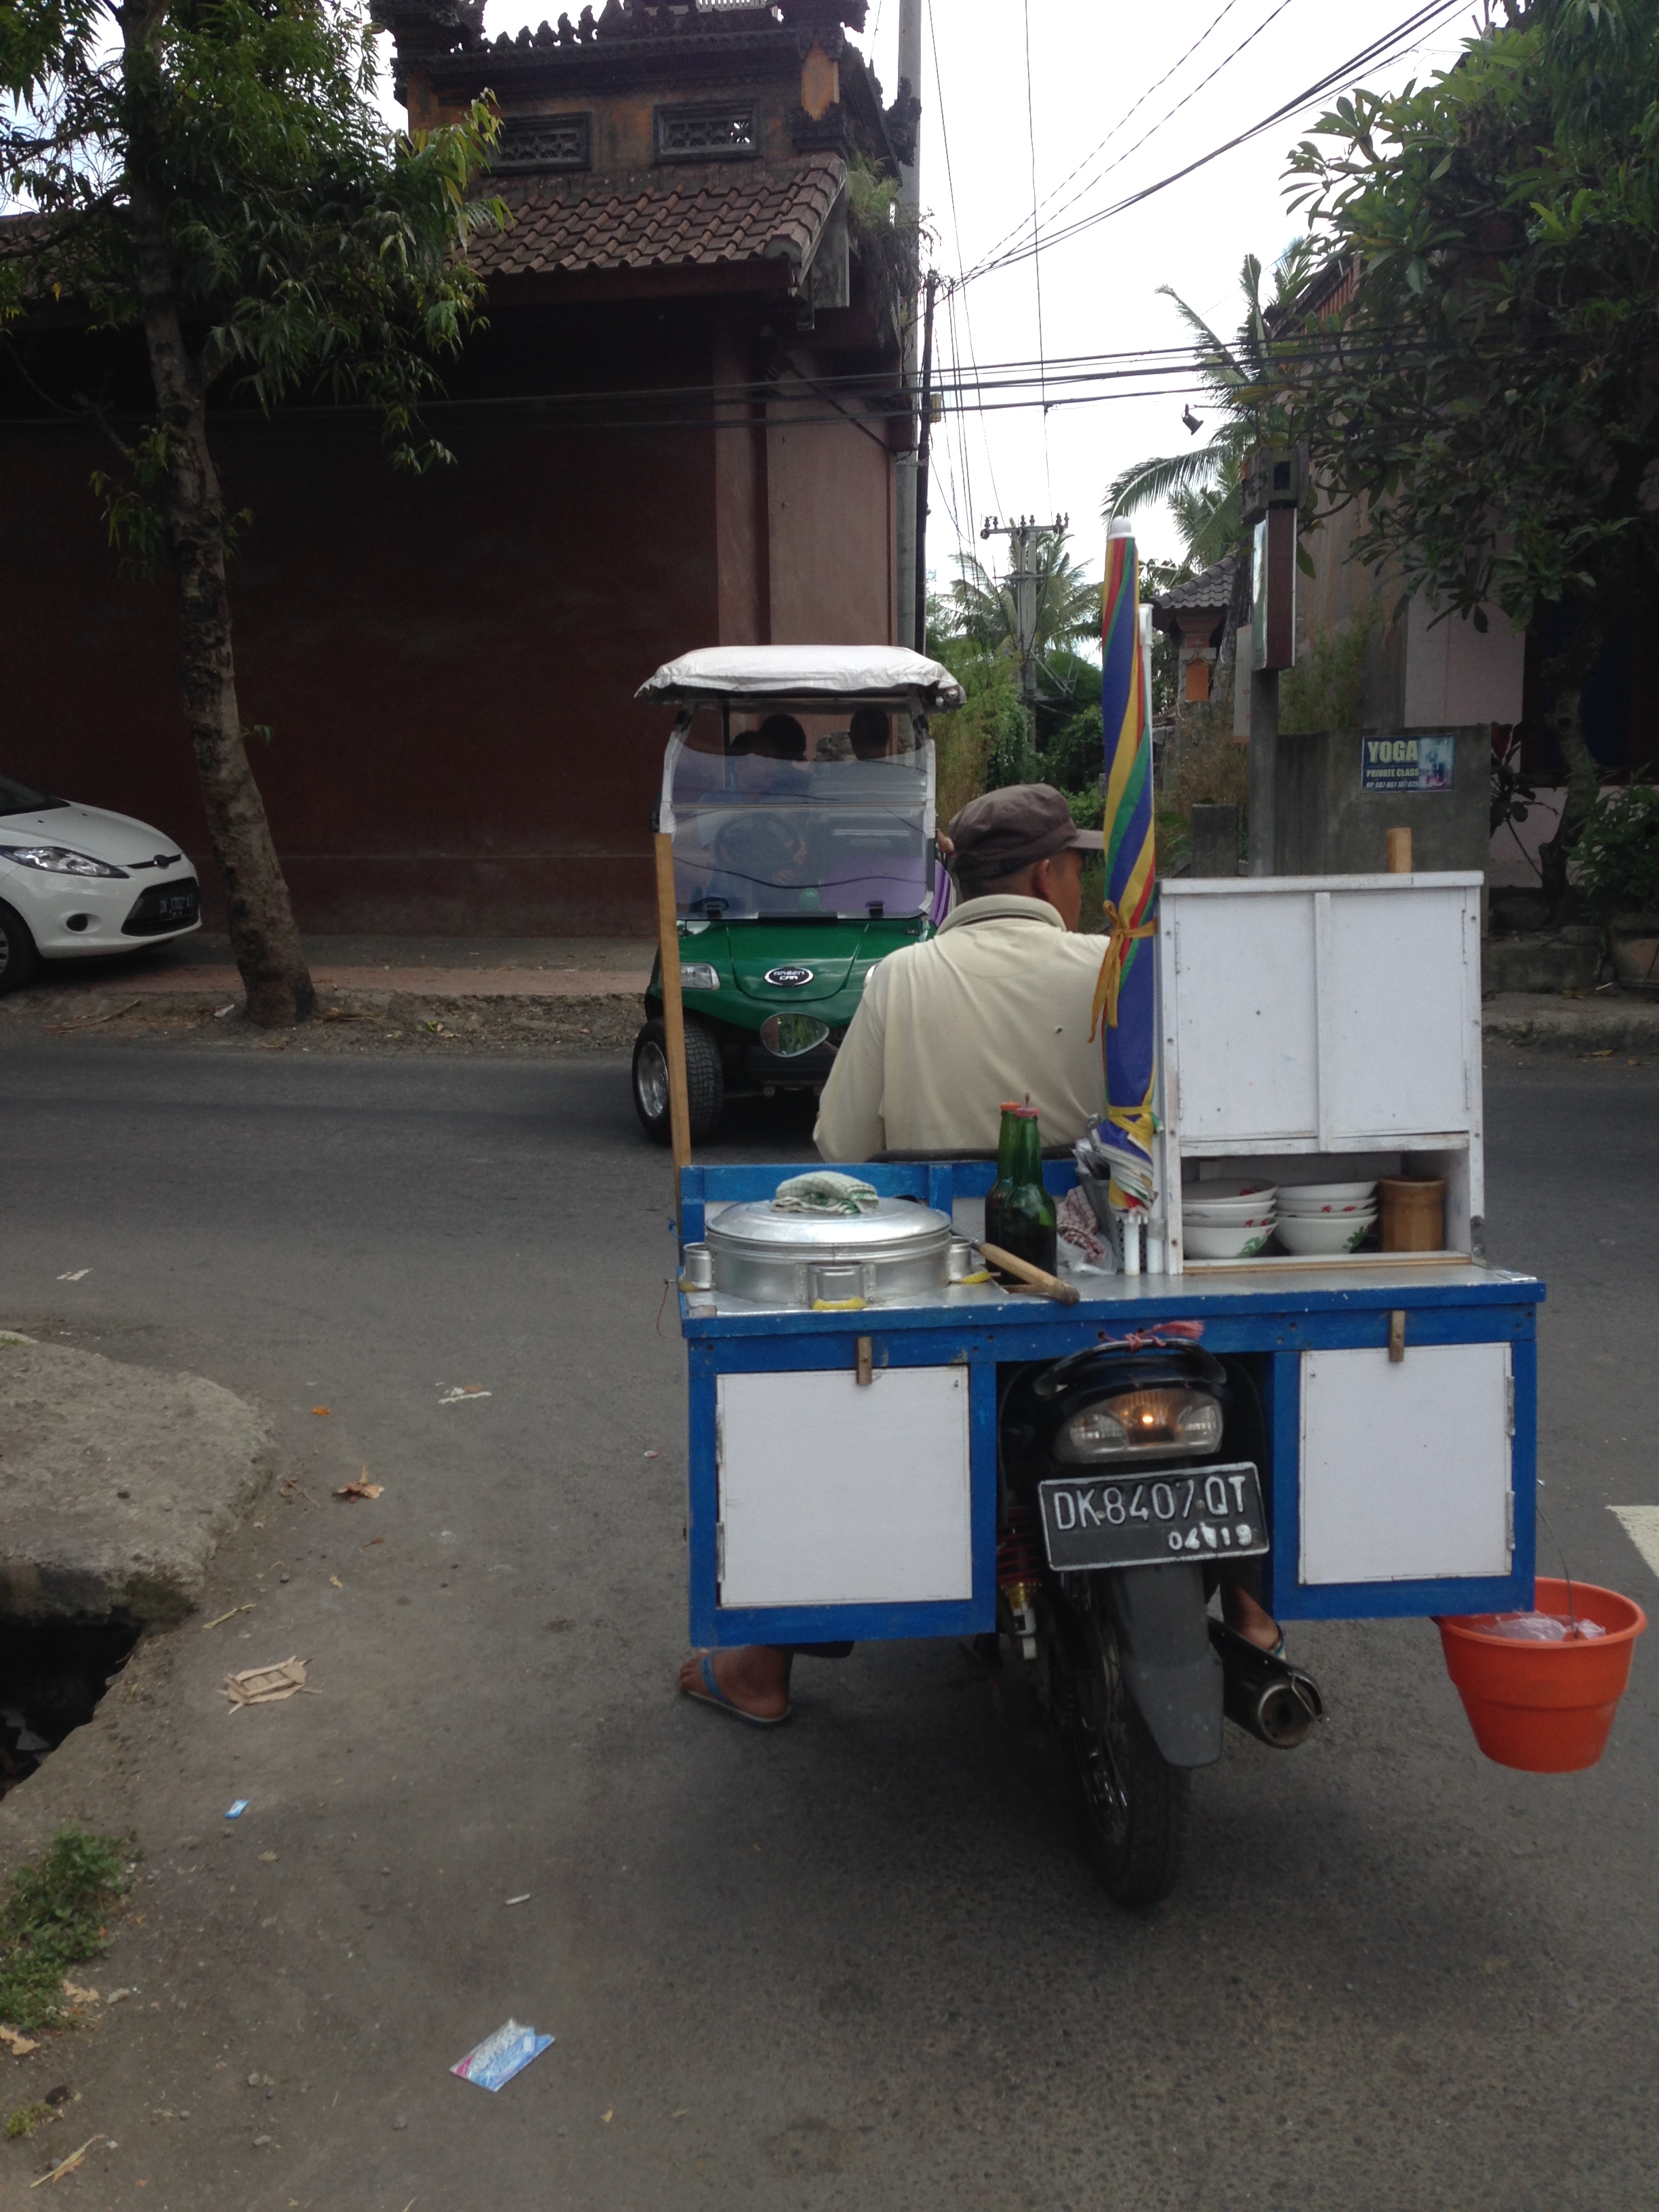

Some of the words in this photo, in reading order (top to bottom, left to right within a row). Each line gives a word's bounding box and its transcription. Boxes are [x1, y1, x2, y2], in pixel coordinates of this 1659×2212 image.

[1368, 740, 1418, 763] YOGA
[1366, 769, 1395, 778] PRIVATE
[1396, 768, 1420, 777] CLASS
